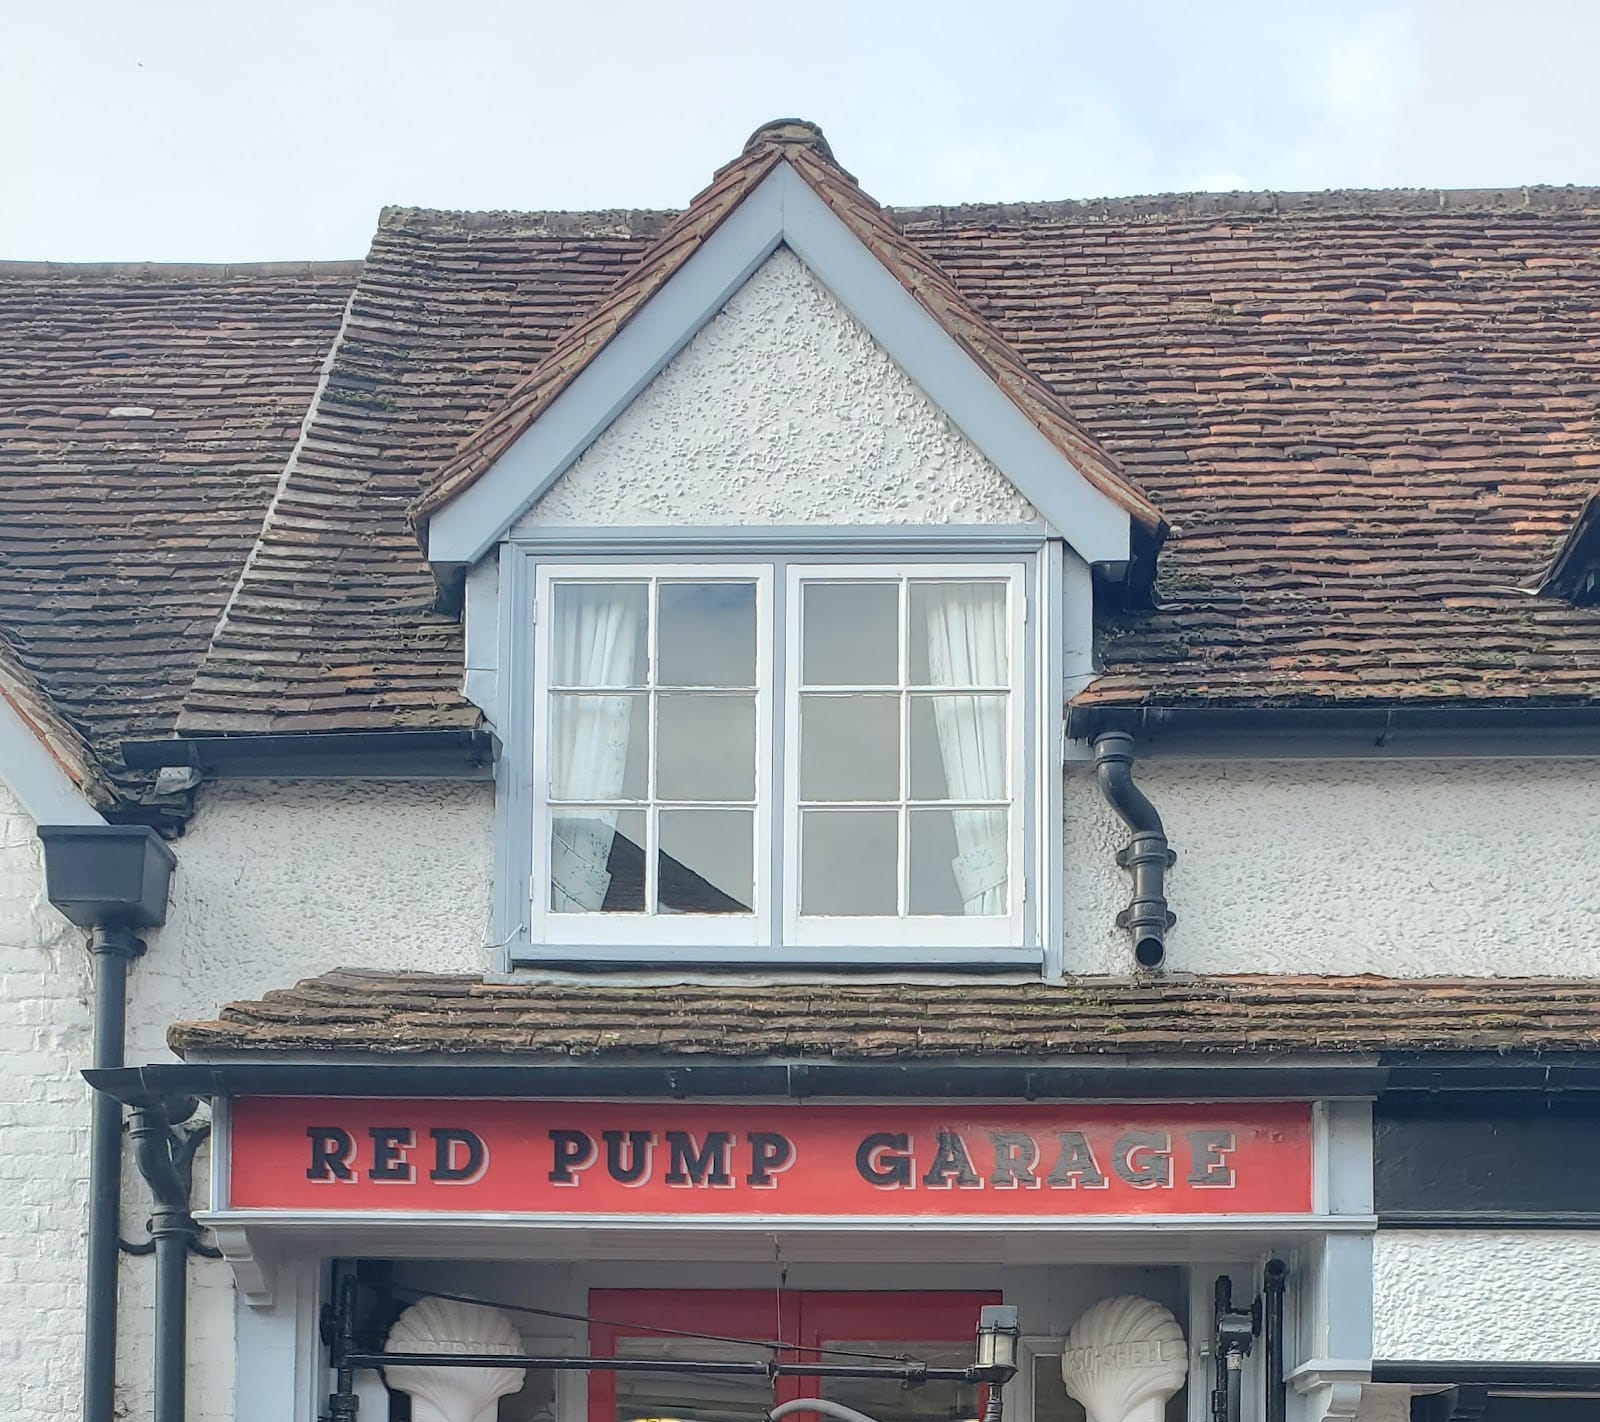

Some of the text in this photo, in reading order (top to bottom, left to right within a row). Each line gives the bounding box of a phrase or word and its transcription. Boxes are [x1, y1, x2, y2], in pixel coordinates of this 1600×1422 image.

[305, 1126, 1237, 1189] RED PUMP GARAGE
